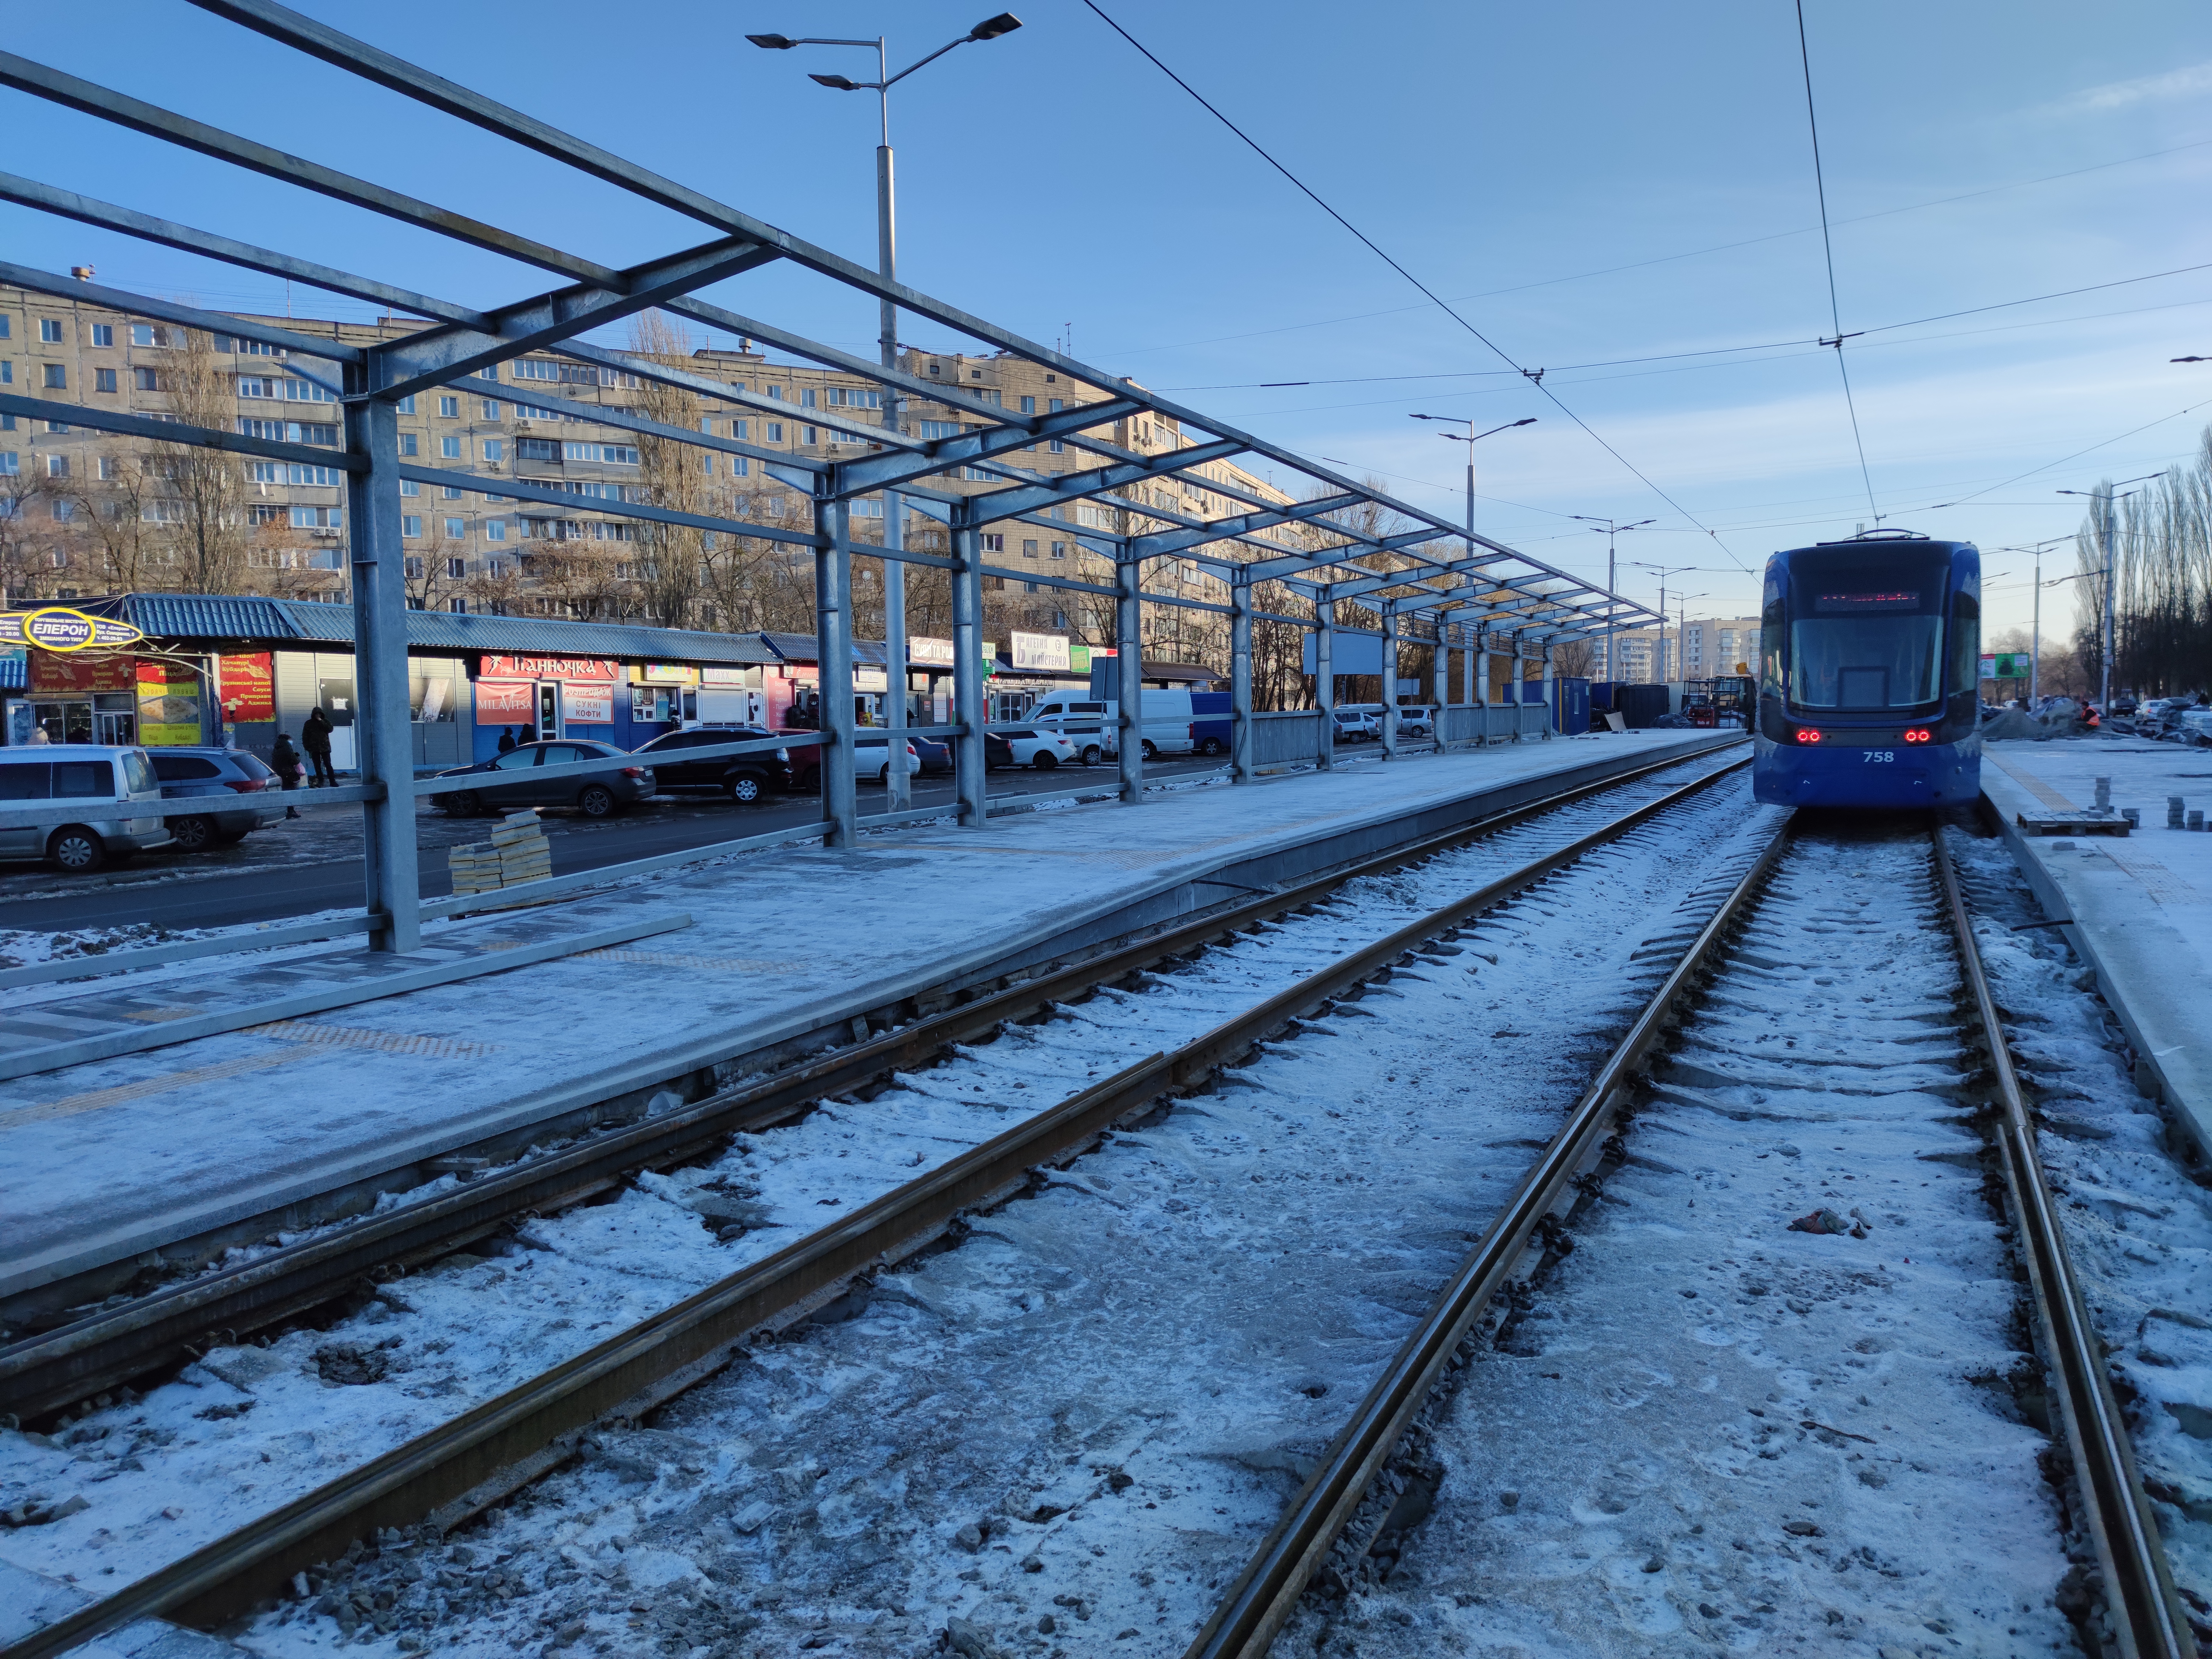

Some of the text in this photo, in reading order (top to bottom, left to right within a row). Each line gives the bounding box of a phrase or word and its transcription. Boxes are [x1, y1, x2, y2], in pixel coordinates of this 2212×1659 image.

[33, 624, 88, 636] ЕЛЕРОН
[932, 645, 941, 658] ТА
[1031, 652, 1066, 666] МАЙСТЕРНЯ
[1073, 659, 1088, 670] ПІЦА
[514, 657, 596, 677] Панночка
[707, 668, 730, 680] Maxx
[564, 687, 611, 697] РОЗПРОДАЖ
[576, 700, 601, 709] СУКНІ
[576, 709, 601, 718] КОФТИ
[1863, 751, 1894, 763] 758
